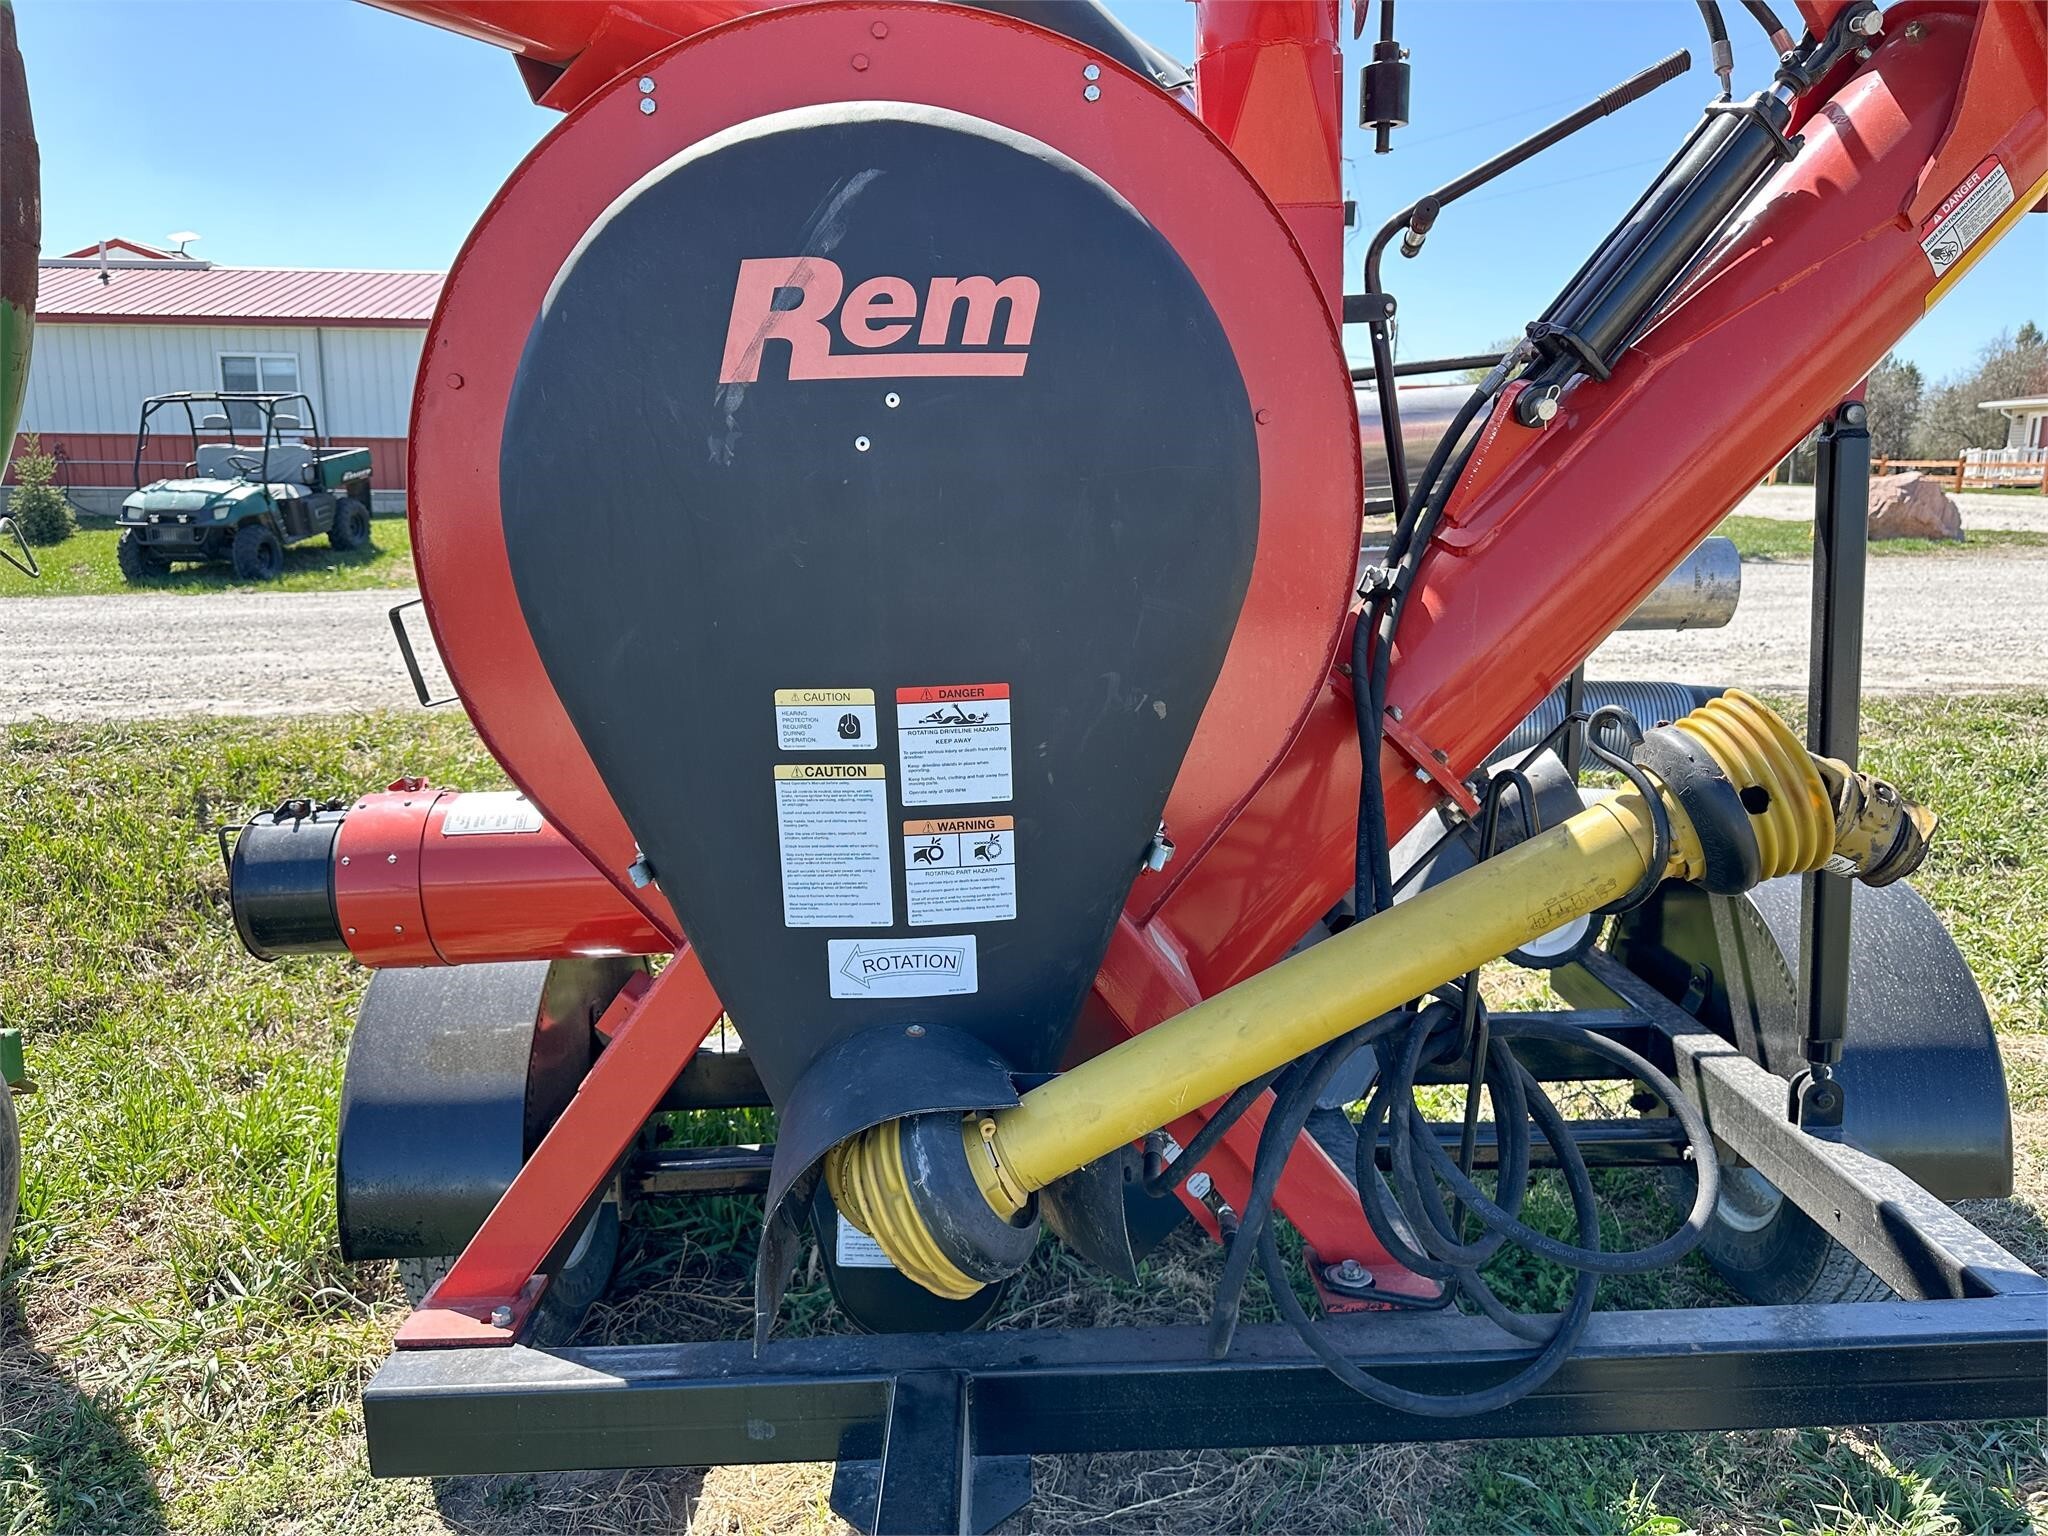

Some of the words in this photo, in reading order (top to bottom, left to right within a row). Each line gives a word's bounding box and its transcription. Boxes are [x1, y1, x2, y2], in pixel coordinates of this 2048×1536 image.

[1941, 172, 1981, 213] DANGER
[1925, 233, 1939, 248] HIGH
[1939, 186, 1985, 235] SUCTION/ROTATING
[1984, 169, 2001, 187] PARTS
[719, 256, 1040, 384] Rem
[803, 693, 851, 702] CAUTION
[938, 688, 985, 699] DANGER
[804, 766, 867, 777] CAUTION
[937, 820, 995, 831] WARNING
[862, 954, 957, 973] ROTATION
